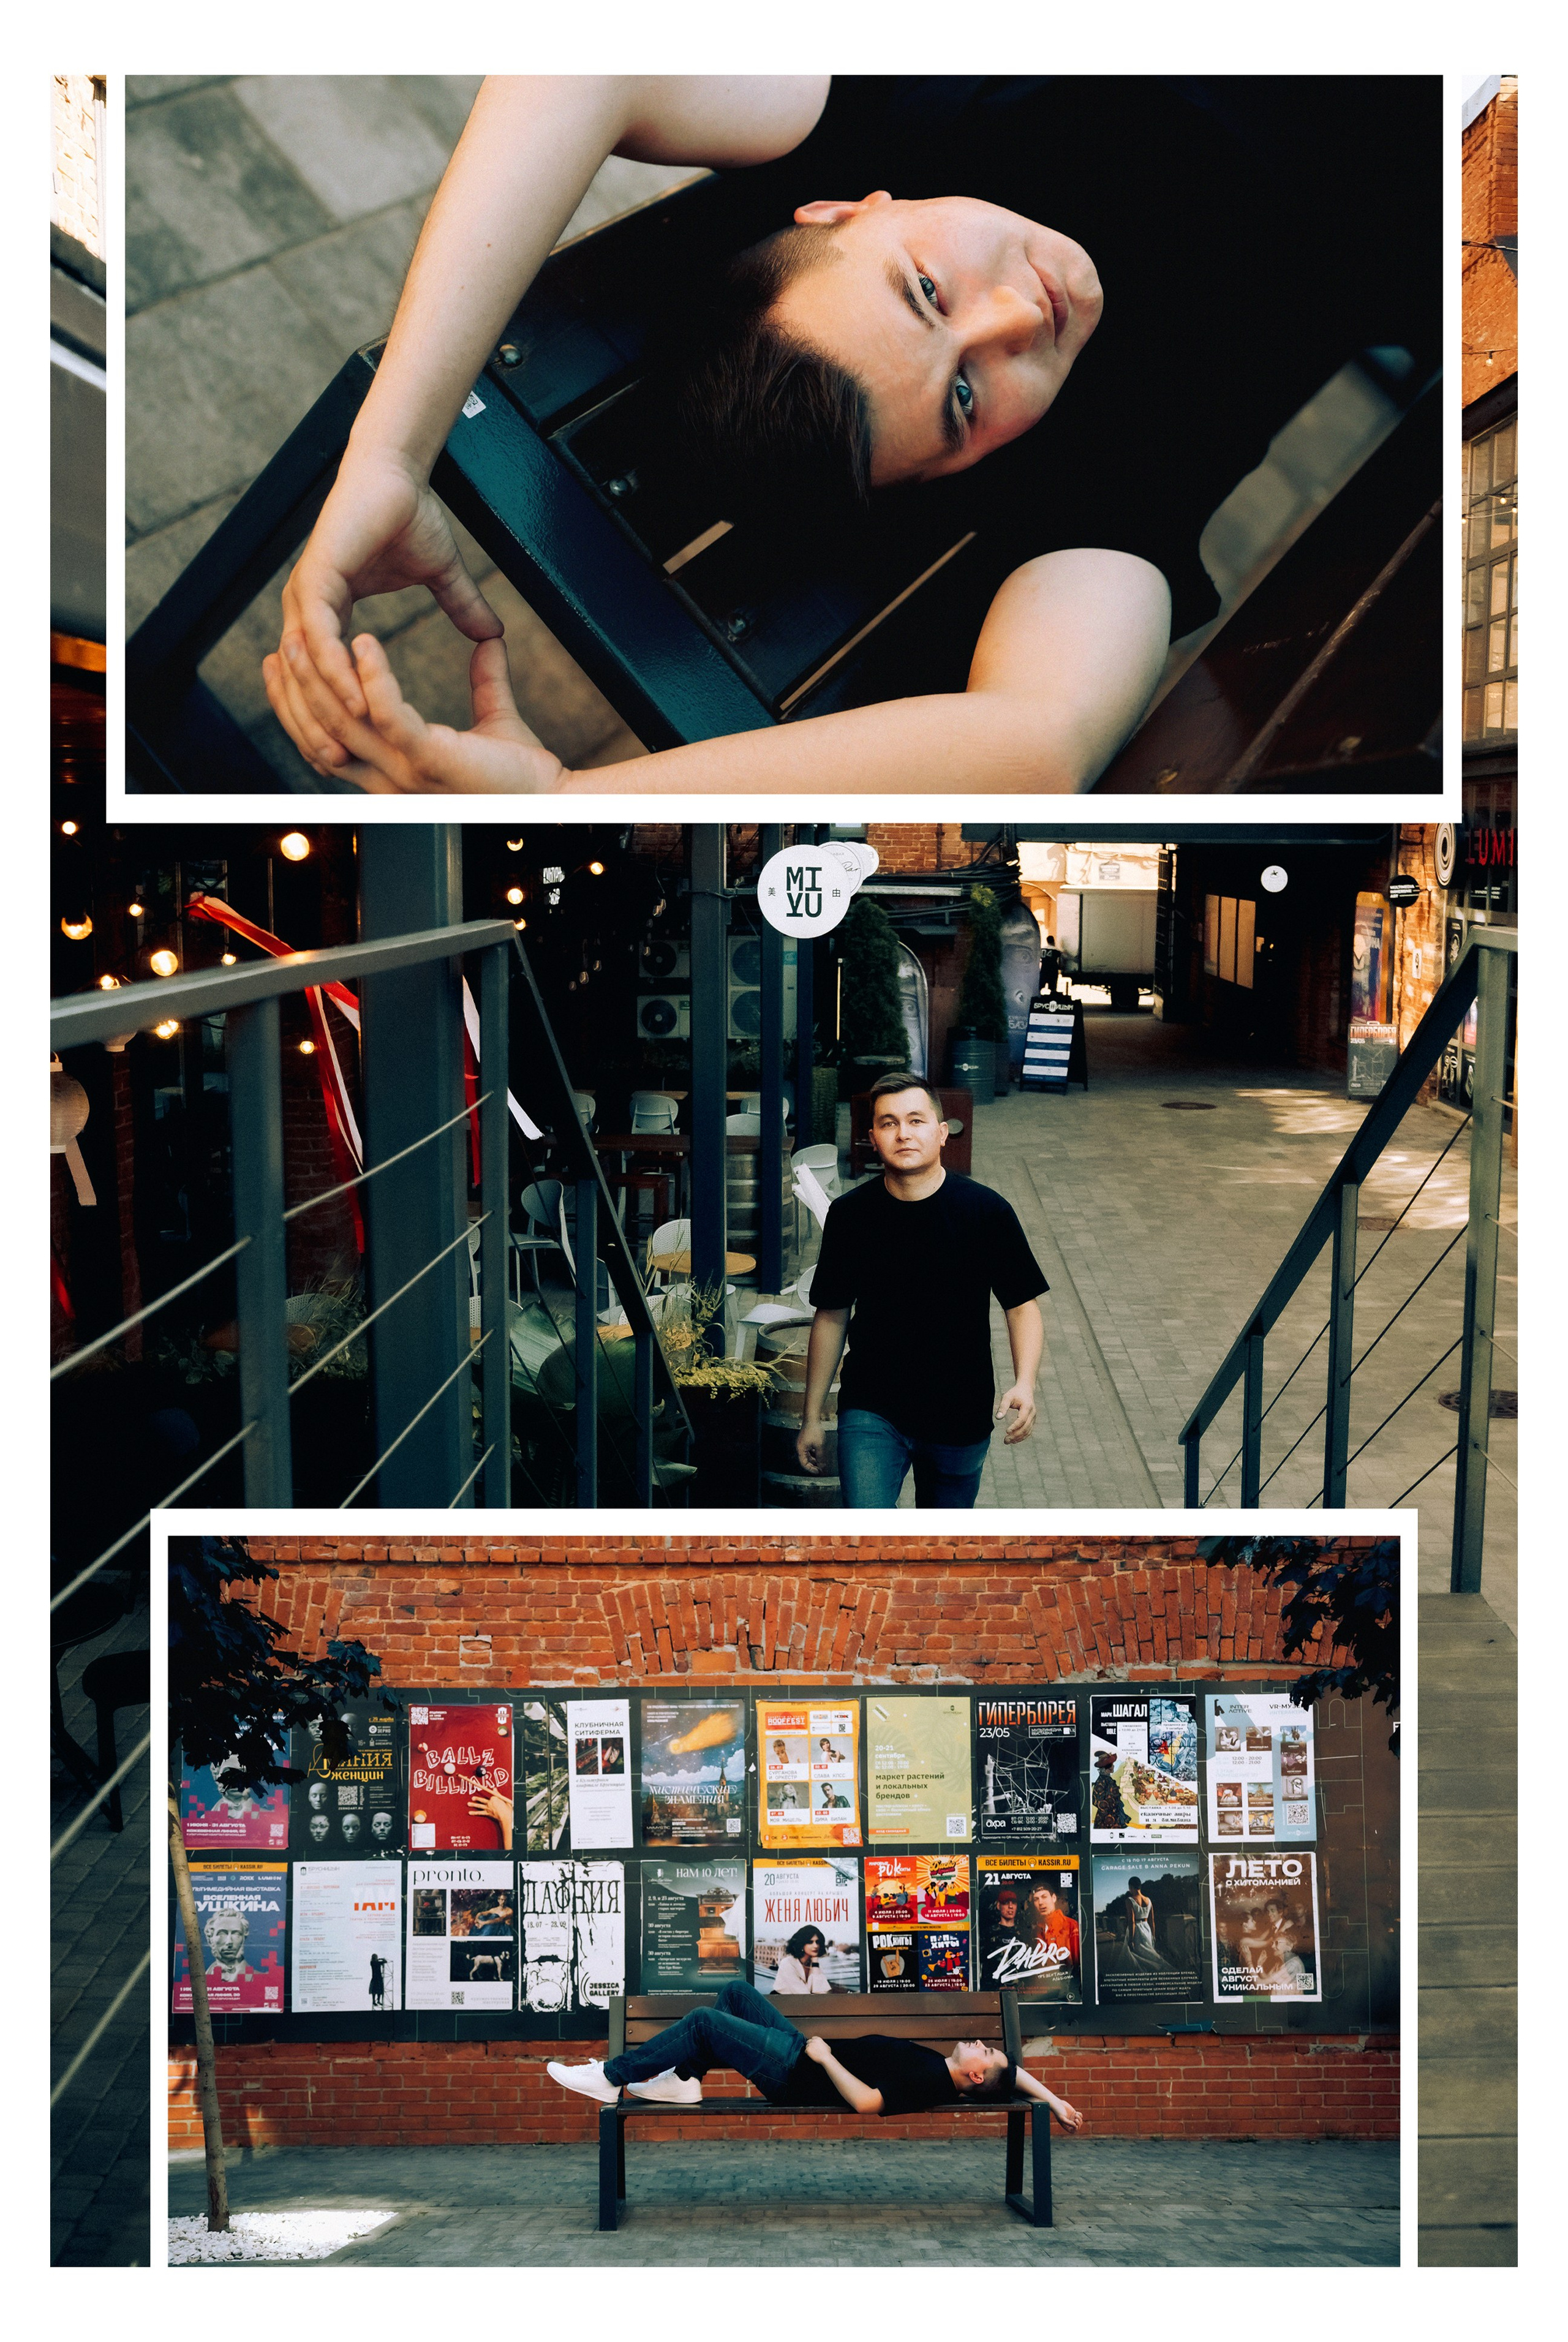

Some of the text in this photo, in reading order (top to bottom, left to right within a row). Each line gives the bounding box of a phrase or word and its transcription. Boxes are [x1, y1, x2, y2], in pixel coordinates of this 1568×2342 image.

[786, 867, 822, 891] MI
[979, 1700, 1076, 1725] ГИПЕРБОРЕЯ
[1113, 1704, 1147, 1717] ШАГАЛ
[979, 1728, 1010, 1738] 23/05
[426, 1747, 494, 1769] BALLZ
[331, 1771, 384, 1782] женщин
[413, 1768, 509, 1794] BILLIARD
[907, 1772, 944, 1781] растений
[703, 1869, 711, 1877] 10
[1226, 1859, 1303, 1878] ЛЕТО
[413, 1869, 484, 1885] pronto.
[764, 1873, 775, 1885] 20
[985, 1873, 1000, 1885] 21
[1234, 1877, 1301, 1886] ХИТОМАНИЕЙ
[523, 1880, 621, 1914] ДАФНИЯ
[766, 1898, 848, 1922] ЖЕНЯ ЛЮБИЧ
[872, 1934, 912, 1949] РОК ХИТЫ
[931, 1940, 959, 1949] ХИТЫ
[1221, 1965, 1263, 1974] СДЕЛАЙ
